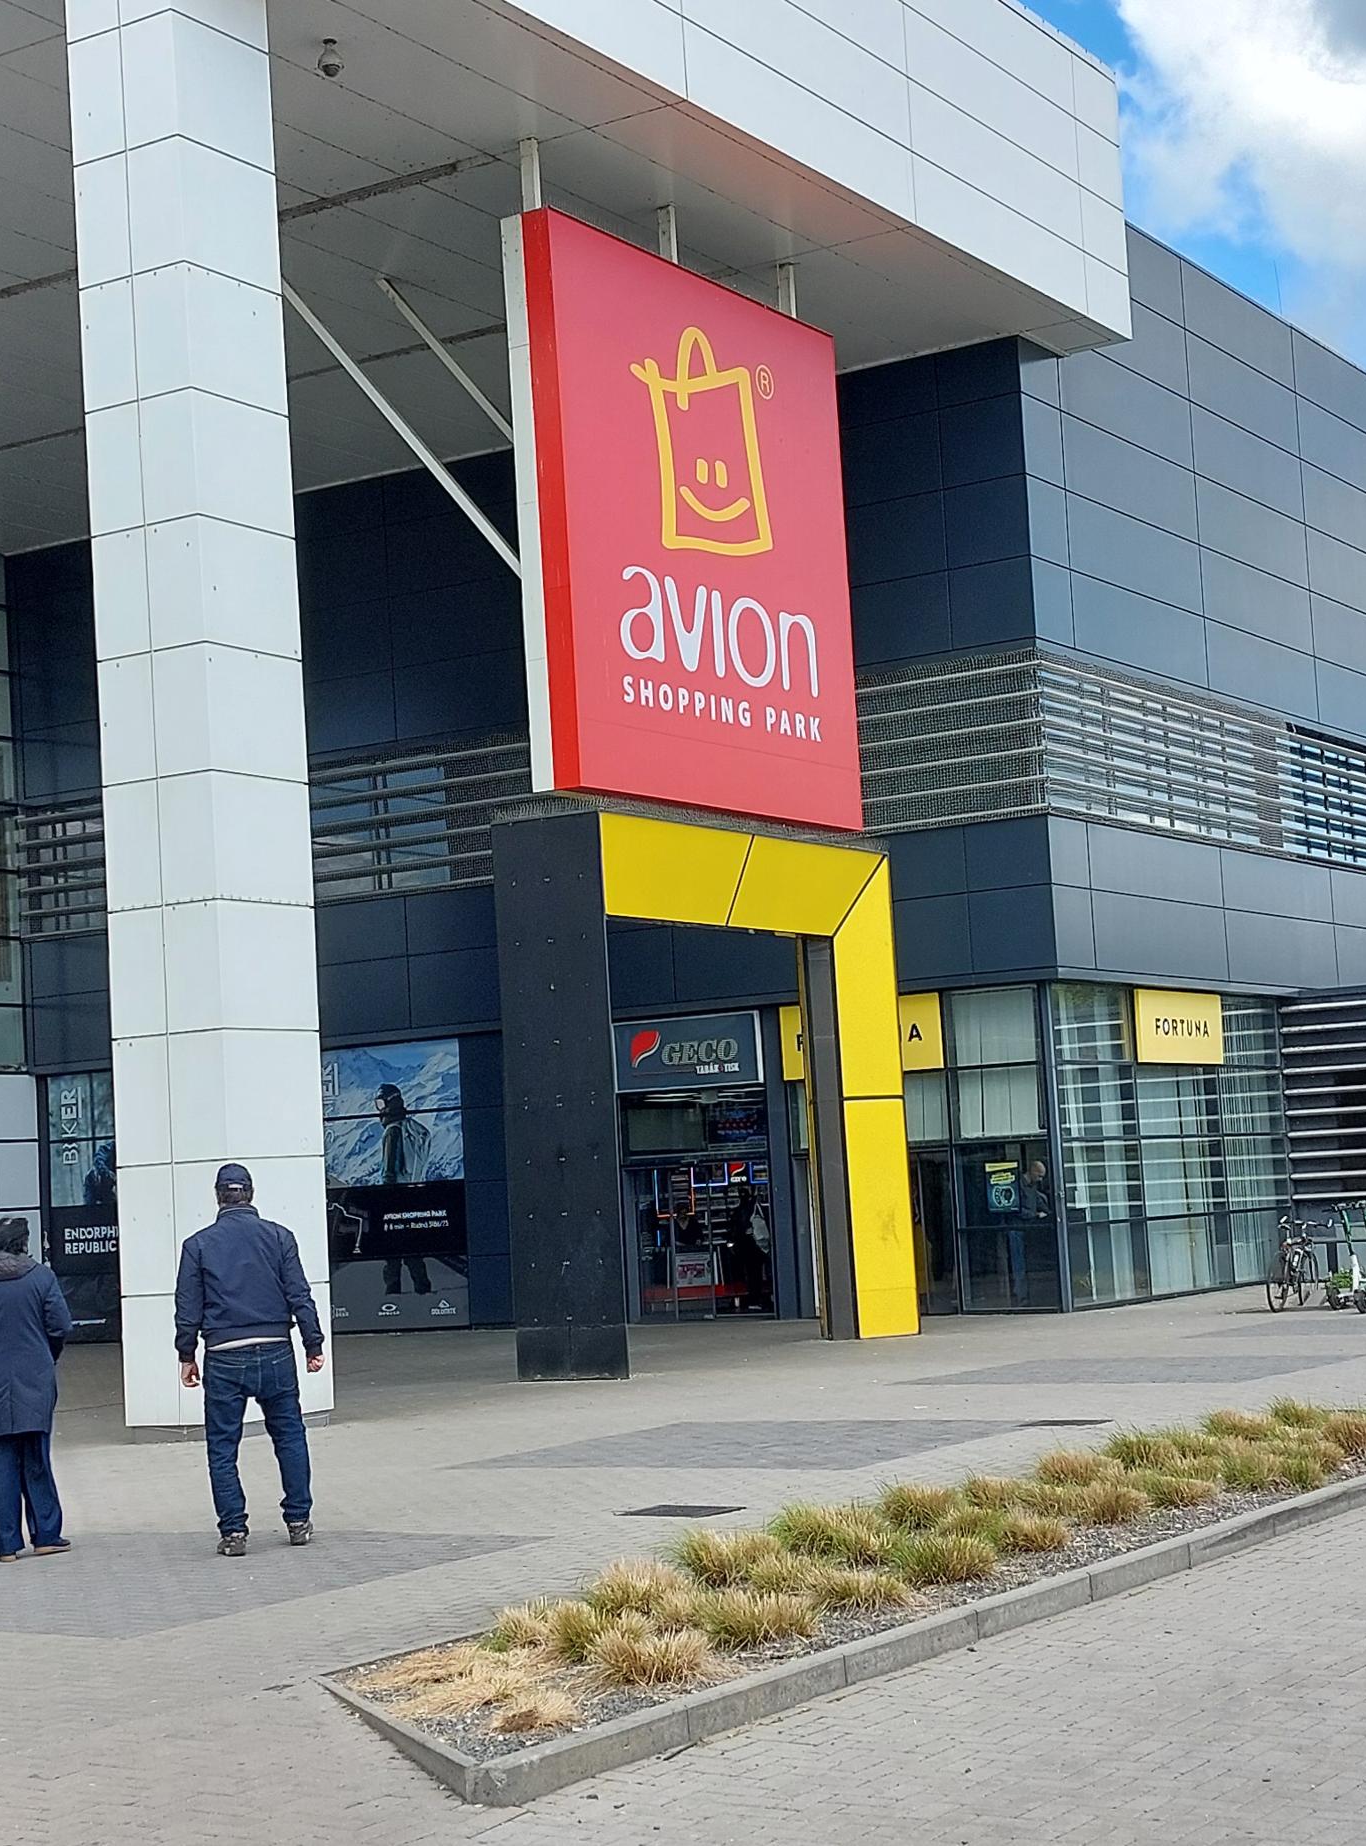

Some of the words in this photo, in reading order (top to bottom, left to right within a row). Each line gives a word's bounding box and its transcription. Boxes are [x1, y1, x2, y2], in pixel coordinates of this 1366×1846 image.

[622, 675, 751, 728] SHOPPING
[766, 704, 823, 743] PARK
[1155, 1018, 1209, 1037] FORTUNA
[662, 1039, 738, 1065] GECO
[61, 1088, 78, 1164] BKER
[64, 1240, 117, 1254] REPUBLIC
